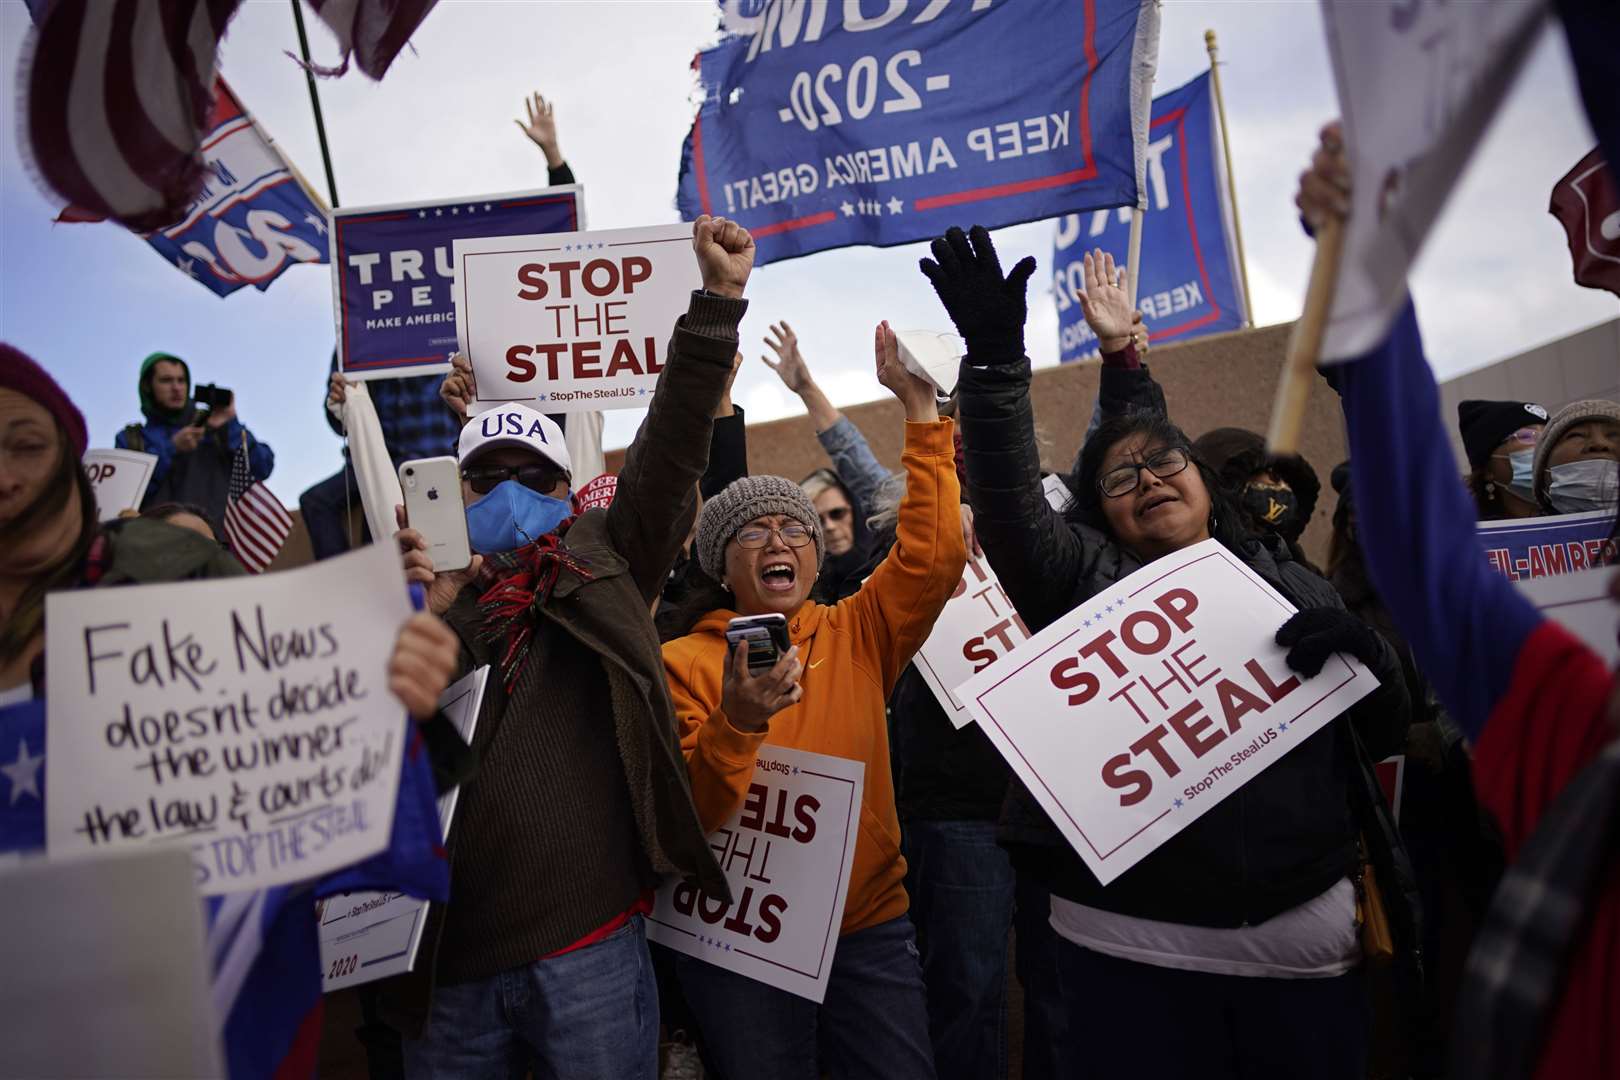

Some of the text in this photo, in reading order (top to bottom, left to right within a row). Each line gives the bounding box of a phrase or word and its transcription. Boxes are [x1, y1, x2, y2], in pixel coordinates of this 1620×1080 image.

[372, 283, 455, 311] PE
[517, 256, 653, 301] STOP
[366, 312, 456, 330] MAKE AMERIC
[545, 301, 629, 338] THE
[505, 337, 667, 383] STEAL
[481, 412, 549, 445] USA
[84, 462, 116, 484] OP
[84, 604, 339, 696] Fake News
[1050, 588, 1200, 706] STOP
[268, 666, 368, 722] decide
[1108, 639, 1222, 724] THE
[1101, 658, 1302, 807] STEAL
[135, 746, 217, 785] the
[75, 806, 145, 845] the
[149, 794, 218, 831] law
[258, 765, 346, 815] courts
